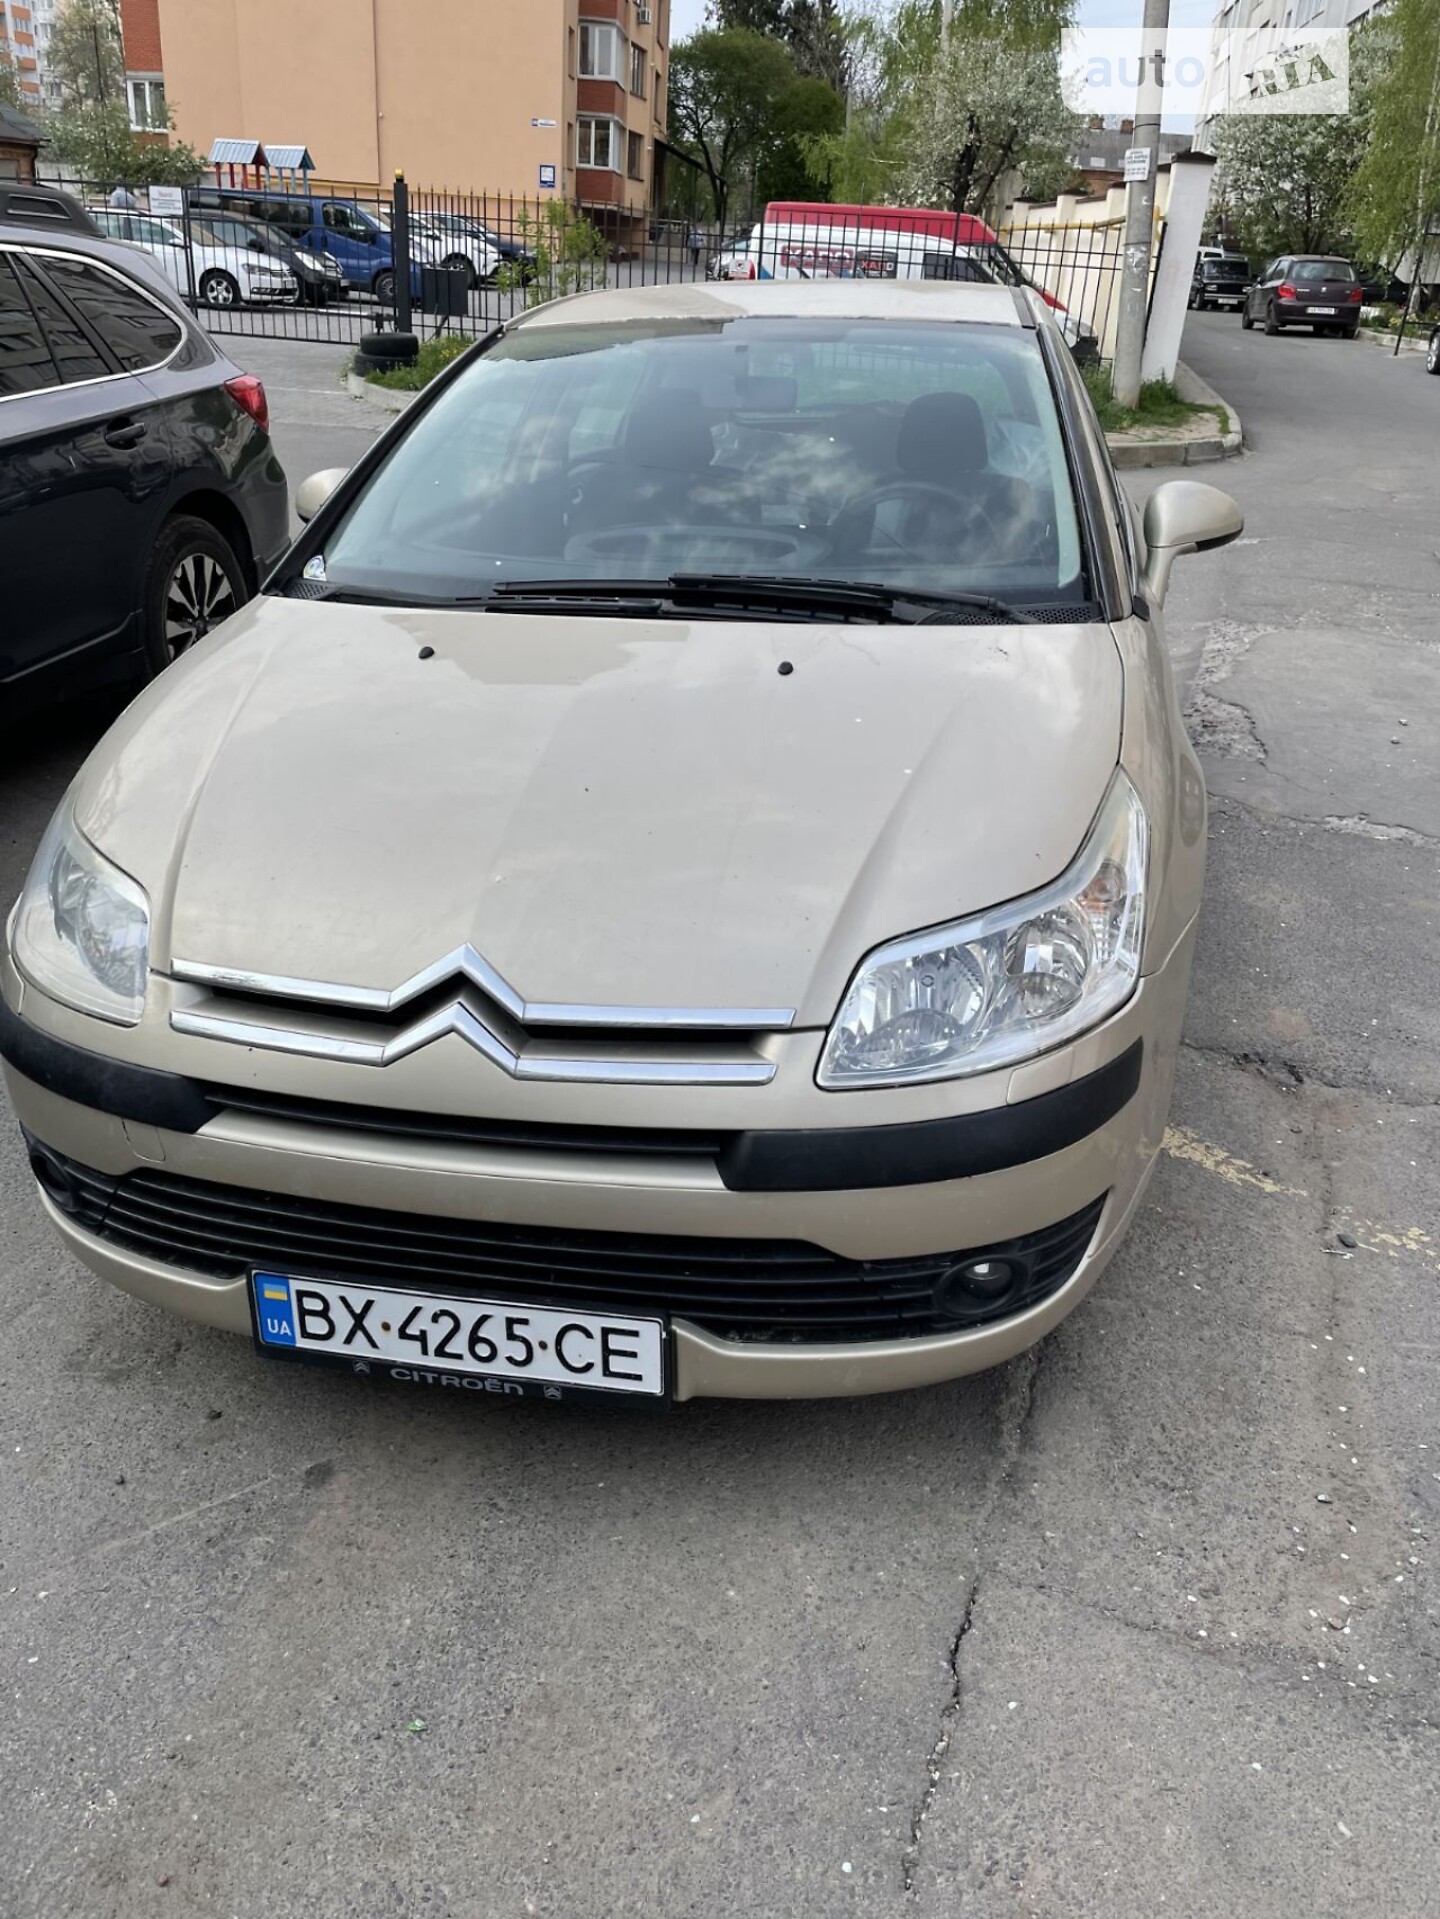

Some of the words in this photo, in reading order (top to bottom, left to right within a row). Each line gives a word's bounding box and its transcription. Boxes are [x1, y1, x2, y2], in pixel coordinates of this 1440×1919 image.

[267, 1318, 292, 1336] UA
[295, 1288, 380, 1350] BX
[397, 1305, 534, 1368] 4265
[554, 1323, 643, 1382] CE
